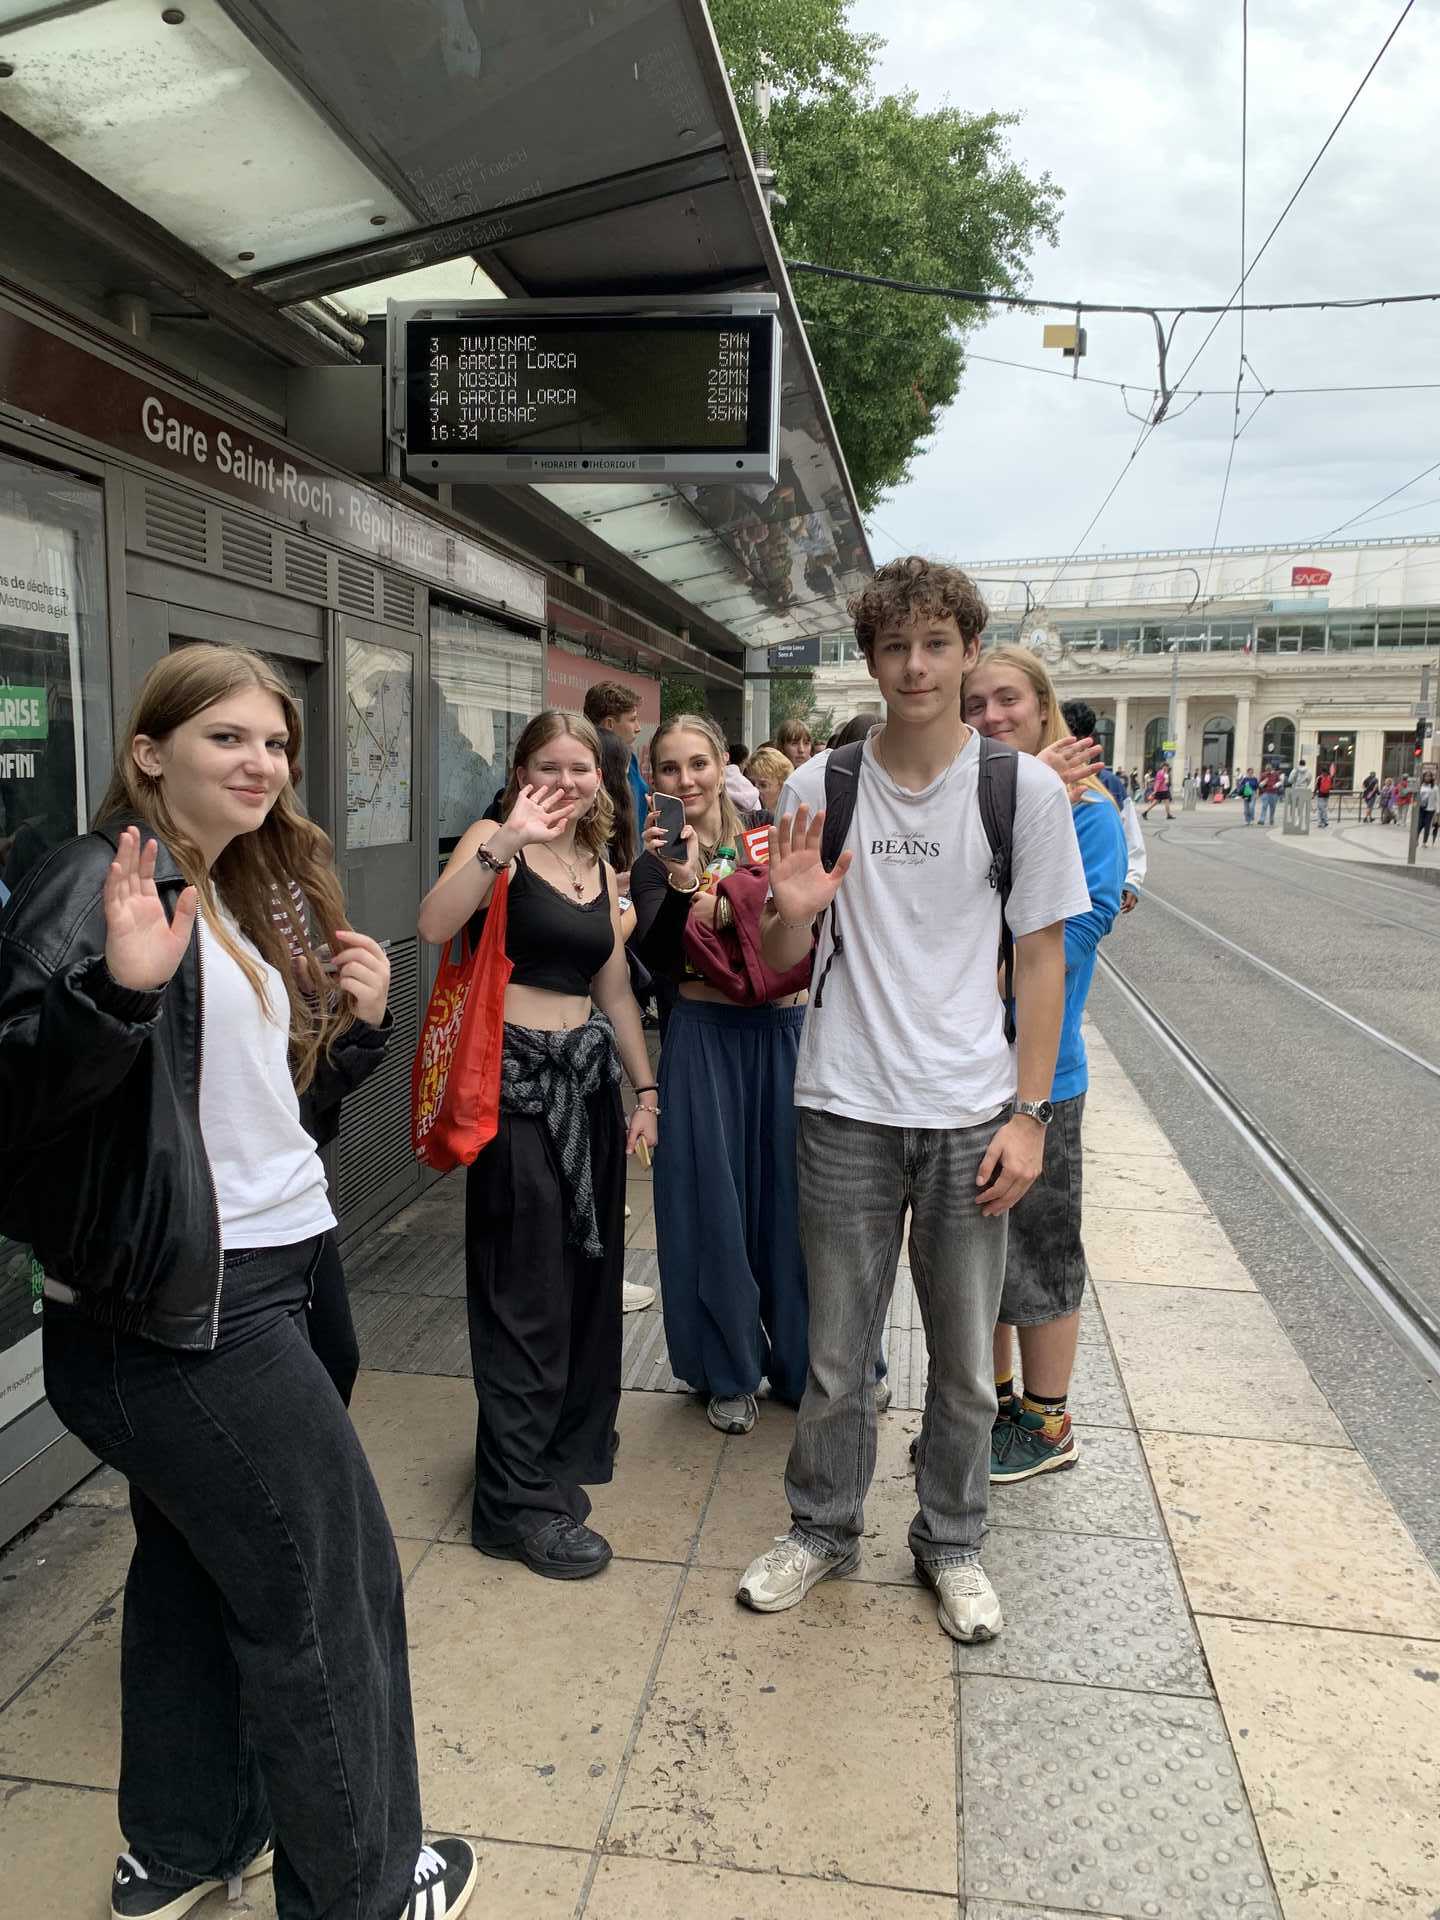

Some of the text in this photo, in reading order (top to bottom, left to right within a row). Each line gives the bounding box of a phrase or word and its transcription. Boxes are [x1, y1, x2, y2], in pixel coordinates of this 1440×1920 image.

[430, 332, 750, 353] 3 JUVIGNAC 5MN
[430, 351, 750, 371] 4A GARCIA LORCA 5MN
[430, 368, 749, 388] 3 MOSSON 20MN
[430, 387, 749, 406] 4A GARCIA LORCA 25MN
[430, 405, 749, 423] 3 JUVIGNAC 35MN
[431, 424, 478, 441] 16:34
[142, 396, 208, 463] Gare
[216, 431, 332, 519] Saint-Roch
[350, 495, 433, 561] République
[10, 575, 25, 590] de
[1294, 573, 1329, 585] SNCF
[870, 840, 941, 857] BEANS
